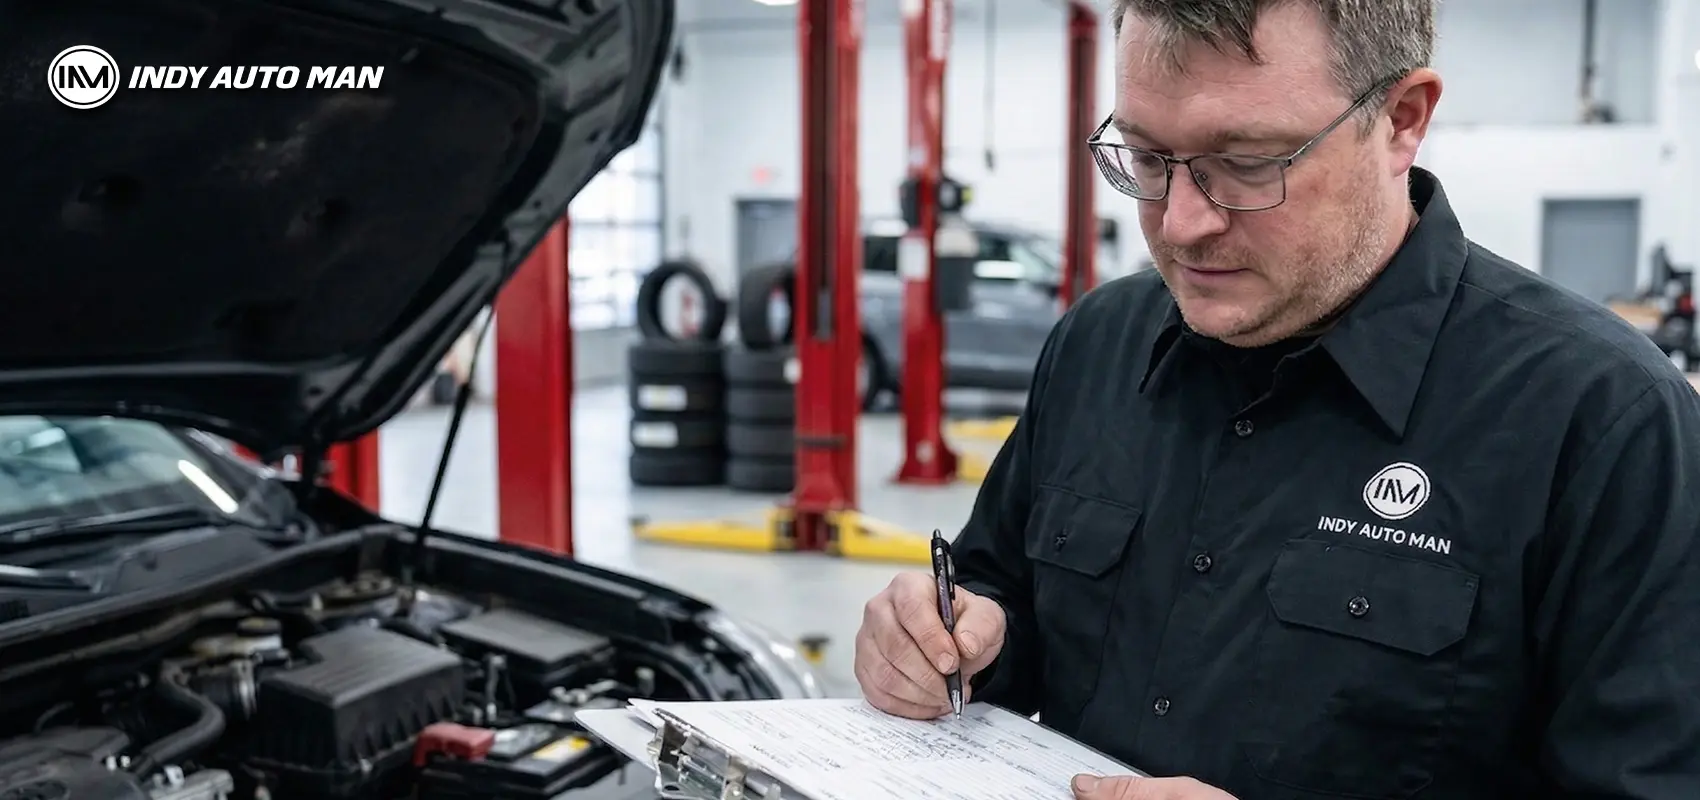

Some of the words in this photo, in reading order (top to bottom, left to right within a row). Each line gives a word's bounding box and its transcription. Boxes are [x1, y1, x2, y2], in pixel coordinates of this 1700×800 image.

[1317, 515, 1358, 534] INDY
[1358, 523, 1406, 544] AUTO
[1408, 532, 1452, 555] MAN
